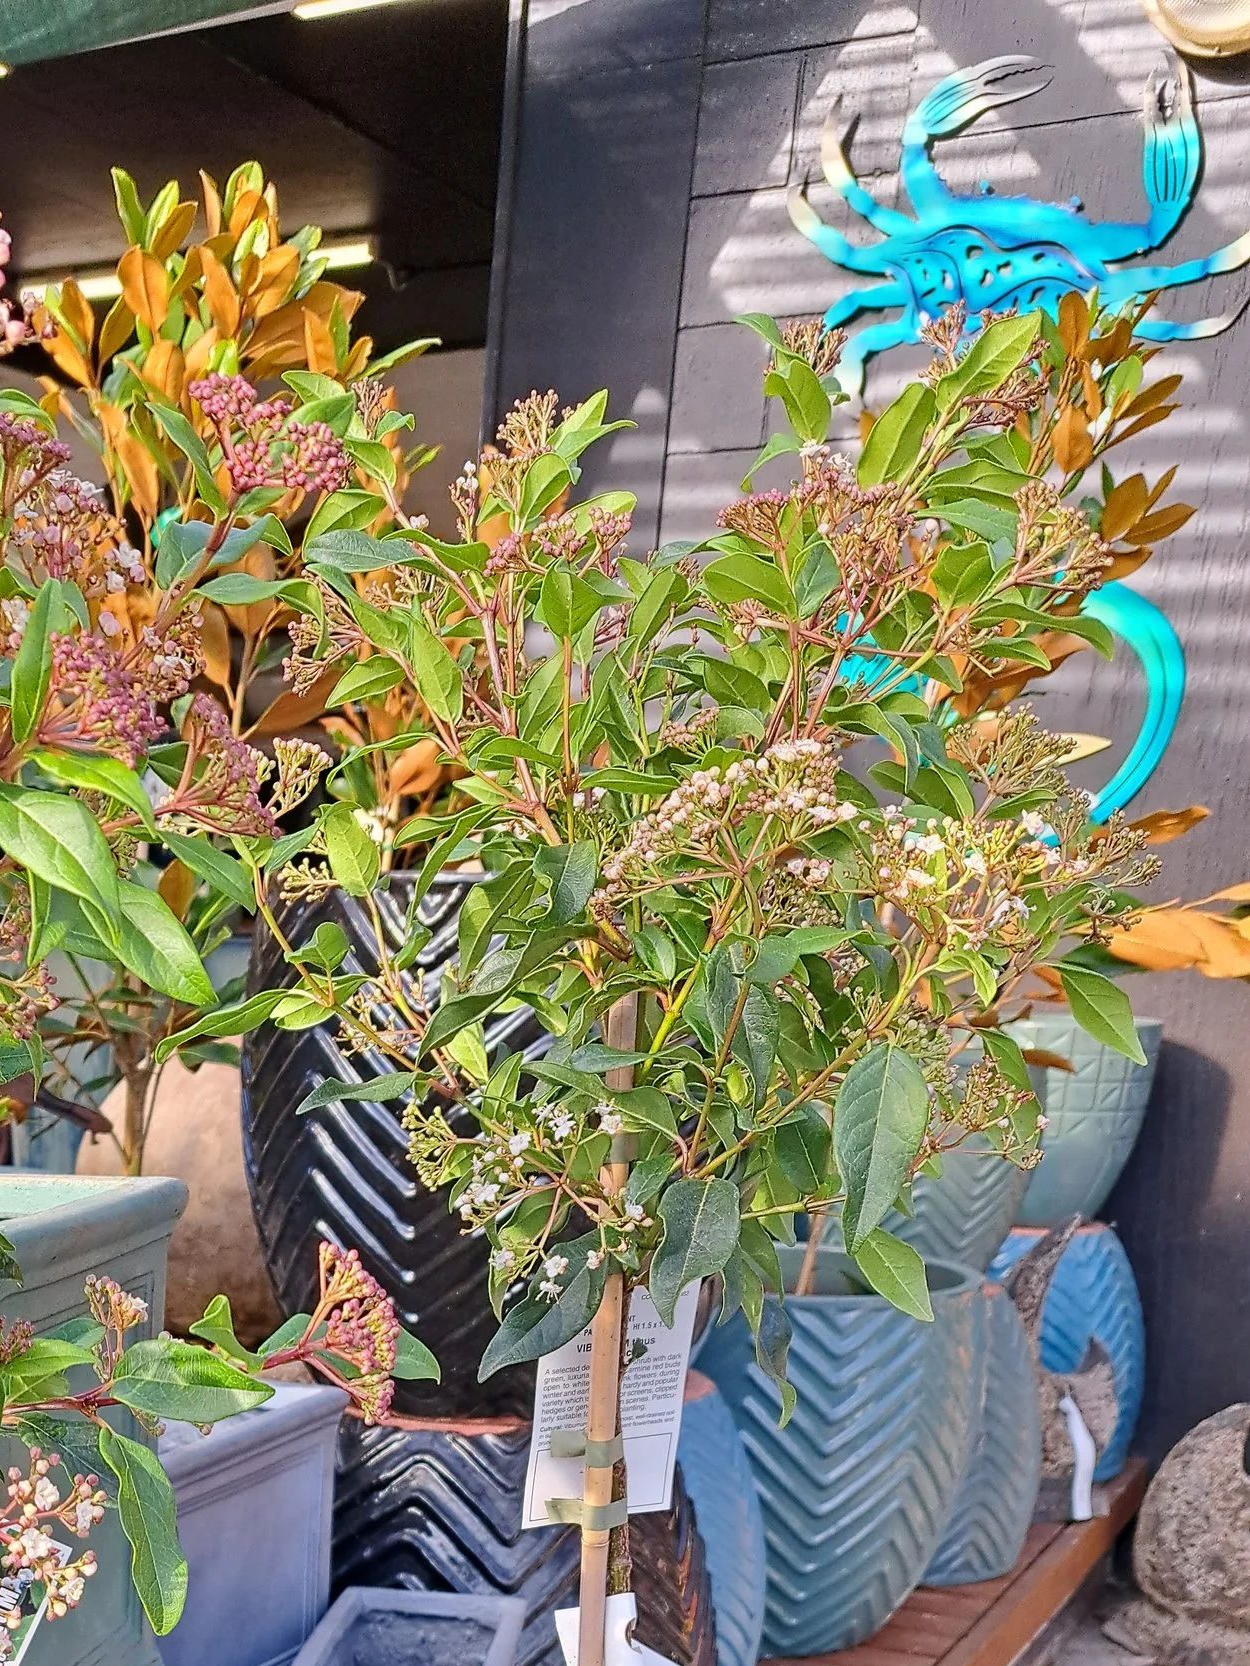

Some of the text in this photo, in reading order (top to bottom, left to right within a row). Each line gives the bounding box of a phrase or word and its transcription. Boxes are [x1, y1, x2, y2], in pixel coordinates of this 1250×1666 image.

[551, 1365, 580, 1375] selected
[652, 1354, 667, 1363] with
[668, 1353, 682, 1361] dark
[567, 1372, 590, 1381] luxuria
[664, 1361, 681, 1369] buds
[542, 1383, 561, 1392] open
[572, 1379, 590, 1388] white
[633, 1371, 658, 1381] flowers
[659, 1368, 680, 1378] during
[542, 1391, 563, 1400] winter
[563, 1389, 577, 1397] and
[622, 1380, 642, 1390] hardy
[642, 1379, 655, 1387] and
[654, 1376, 679, 1386] popular
[541, 1398, 564, 1408] variety
[565, 1395, 584, 1405] which
[654, 1383, 678, 1393] clipped
[540, 1415, 555, 1423] larly
[556, 1412, 582, 1422] suitable
[541, 1406, 566, 1415] hedges
